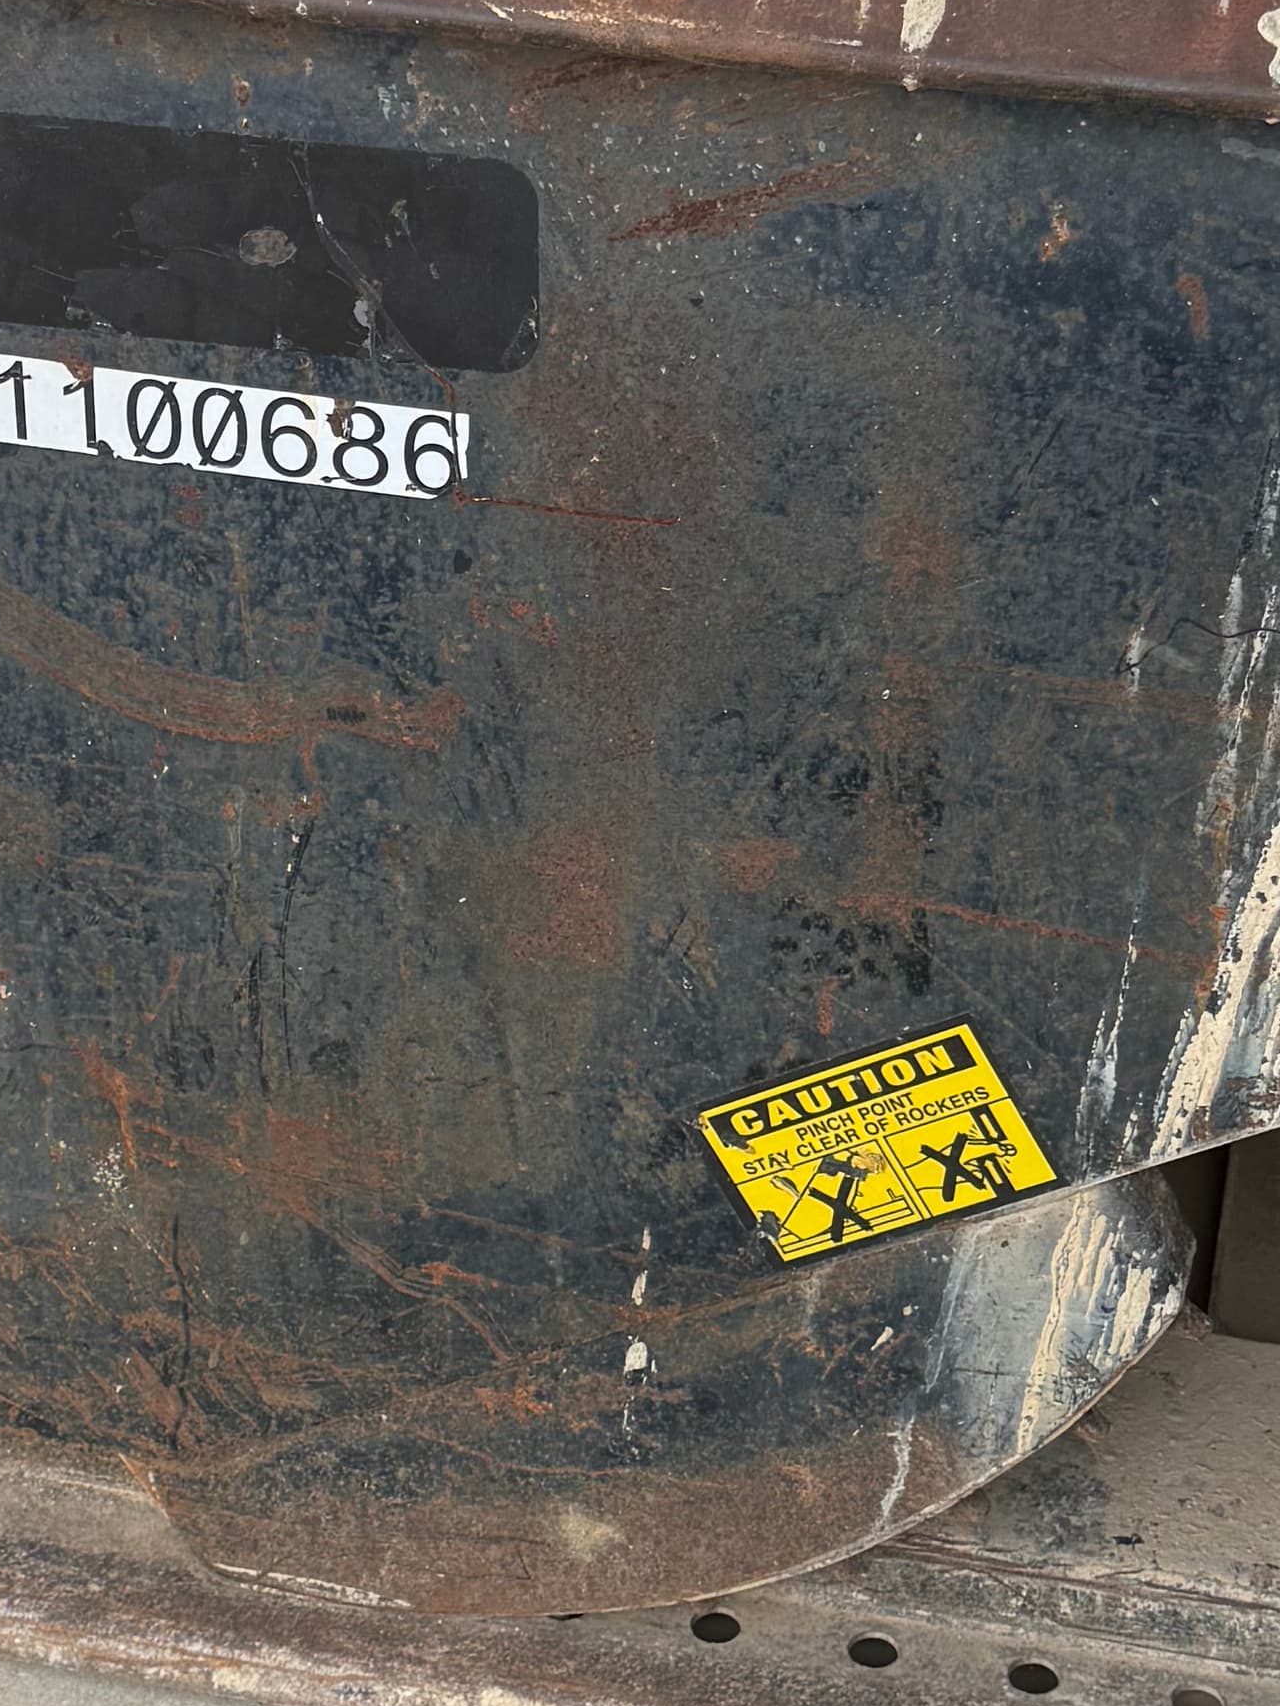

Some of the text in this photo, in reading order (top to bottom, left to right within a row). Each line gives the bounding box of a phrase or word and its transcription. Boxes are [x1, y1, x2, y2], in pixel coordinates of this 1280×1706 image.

[730, 1044, 956, 1138] CAUTION
[743, 1086, 991, 1176] STAY CLEAR OF ROCKERS
[795, 1093, 915, 1142] PINCH POINT
